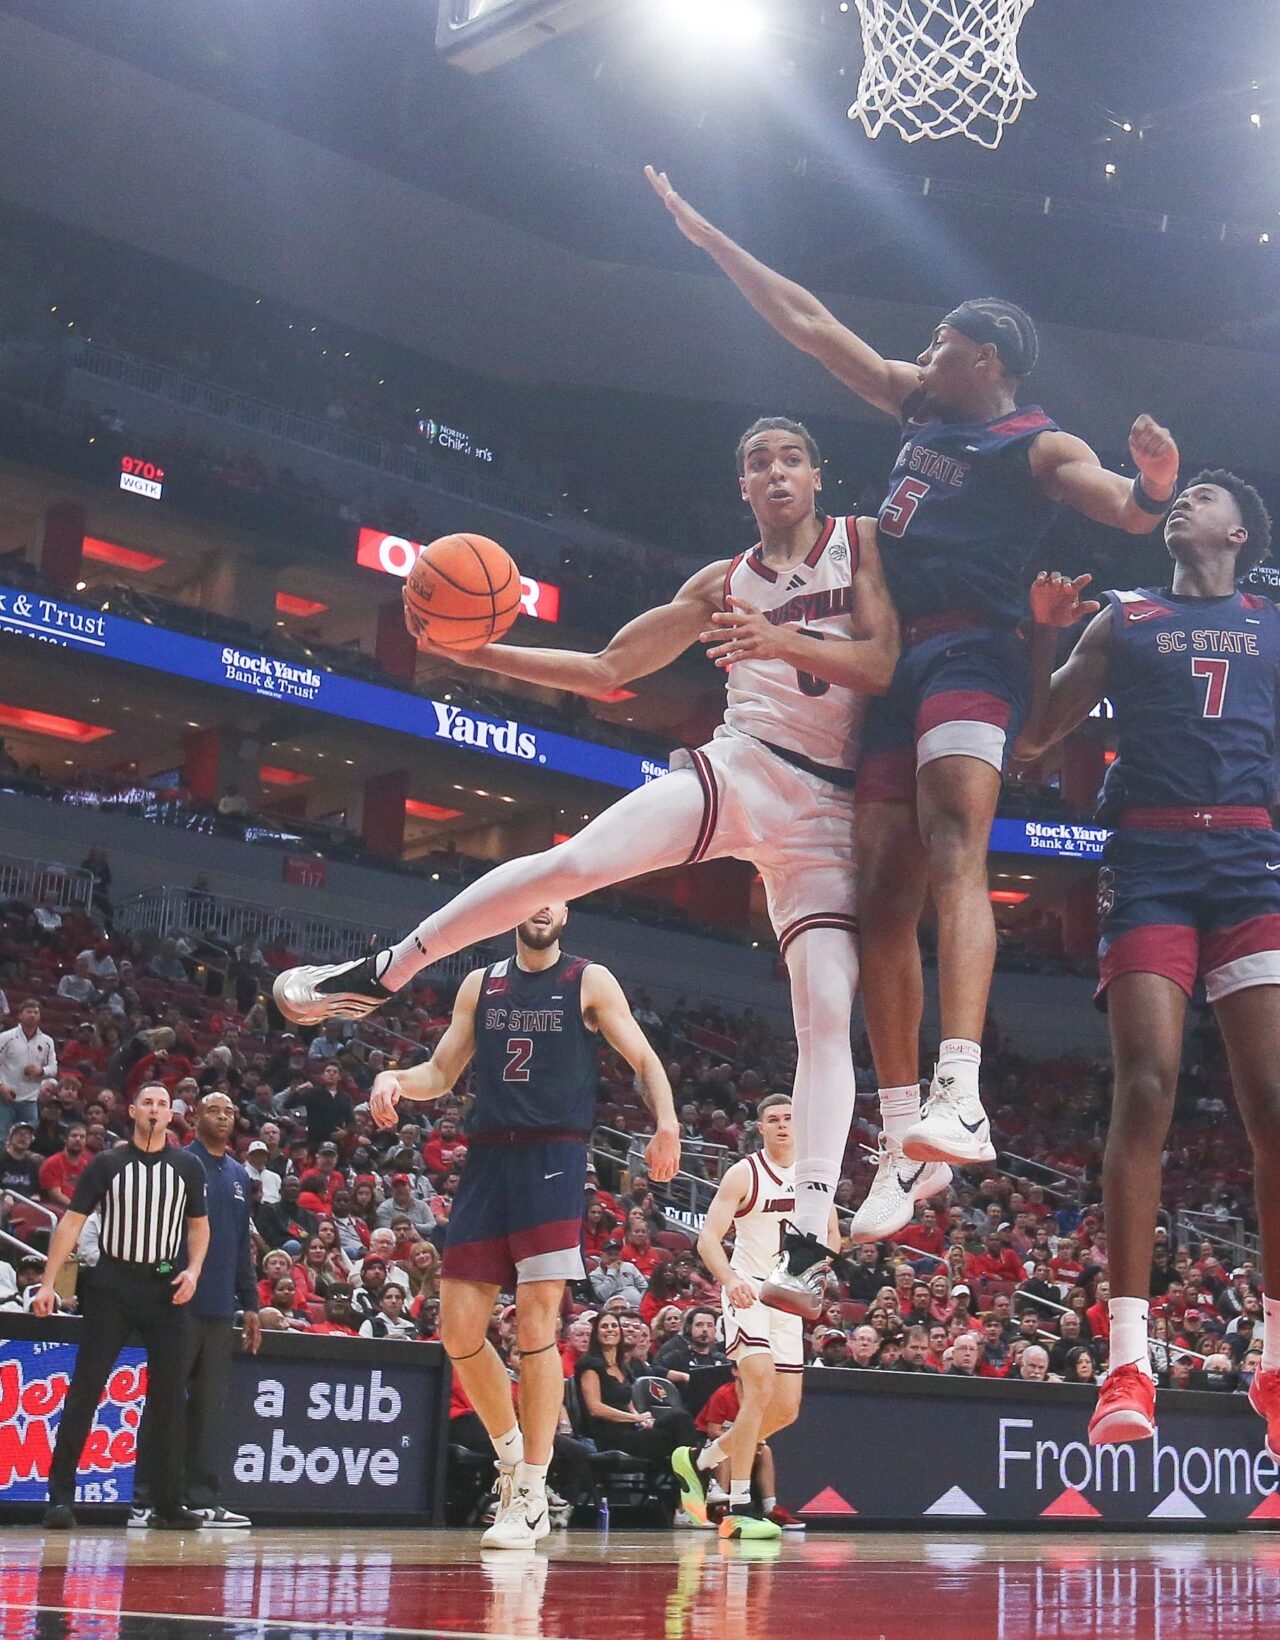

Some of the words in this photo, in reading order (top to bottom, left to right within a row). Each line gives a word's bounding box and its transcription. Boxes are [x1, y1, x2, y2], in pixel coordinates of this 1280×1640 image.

[909, 445, 971, 488] STATE
[879, 475, 931, 538] 5
[12, 594, 33, 618] &
[39, 599, 106, 636] Trust
[1156, 632, 1188, 654] SC
[1191, 629, 1260, 656] STATE
[225, 665, 261, 686] Bank
[263, 675, 275, 690] &
[1190, 656, 1230, 718] 7
[432, 700, 537, 760] Yards
[1030, 836, 1062, 849] Bank
[1064, 840, 1075, 850] &
[485, 1008, 507, 1030] SC
[508, 1009, 564, 1032] STATE
[502, 1038, 534, 1081] 2
[253, 1379, 285, 1418] a
[306, 1370, 402, 1422] sub
[998, 1417, 1137, 1492] From
[1151, 1425, 1280, 1496] home
